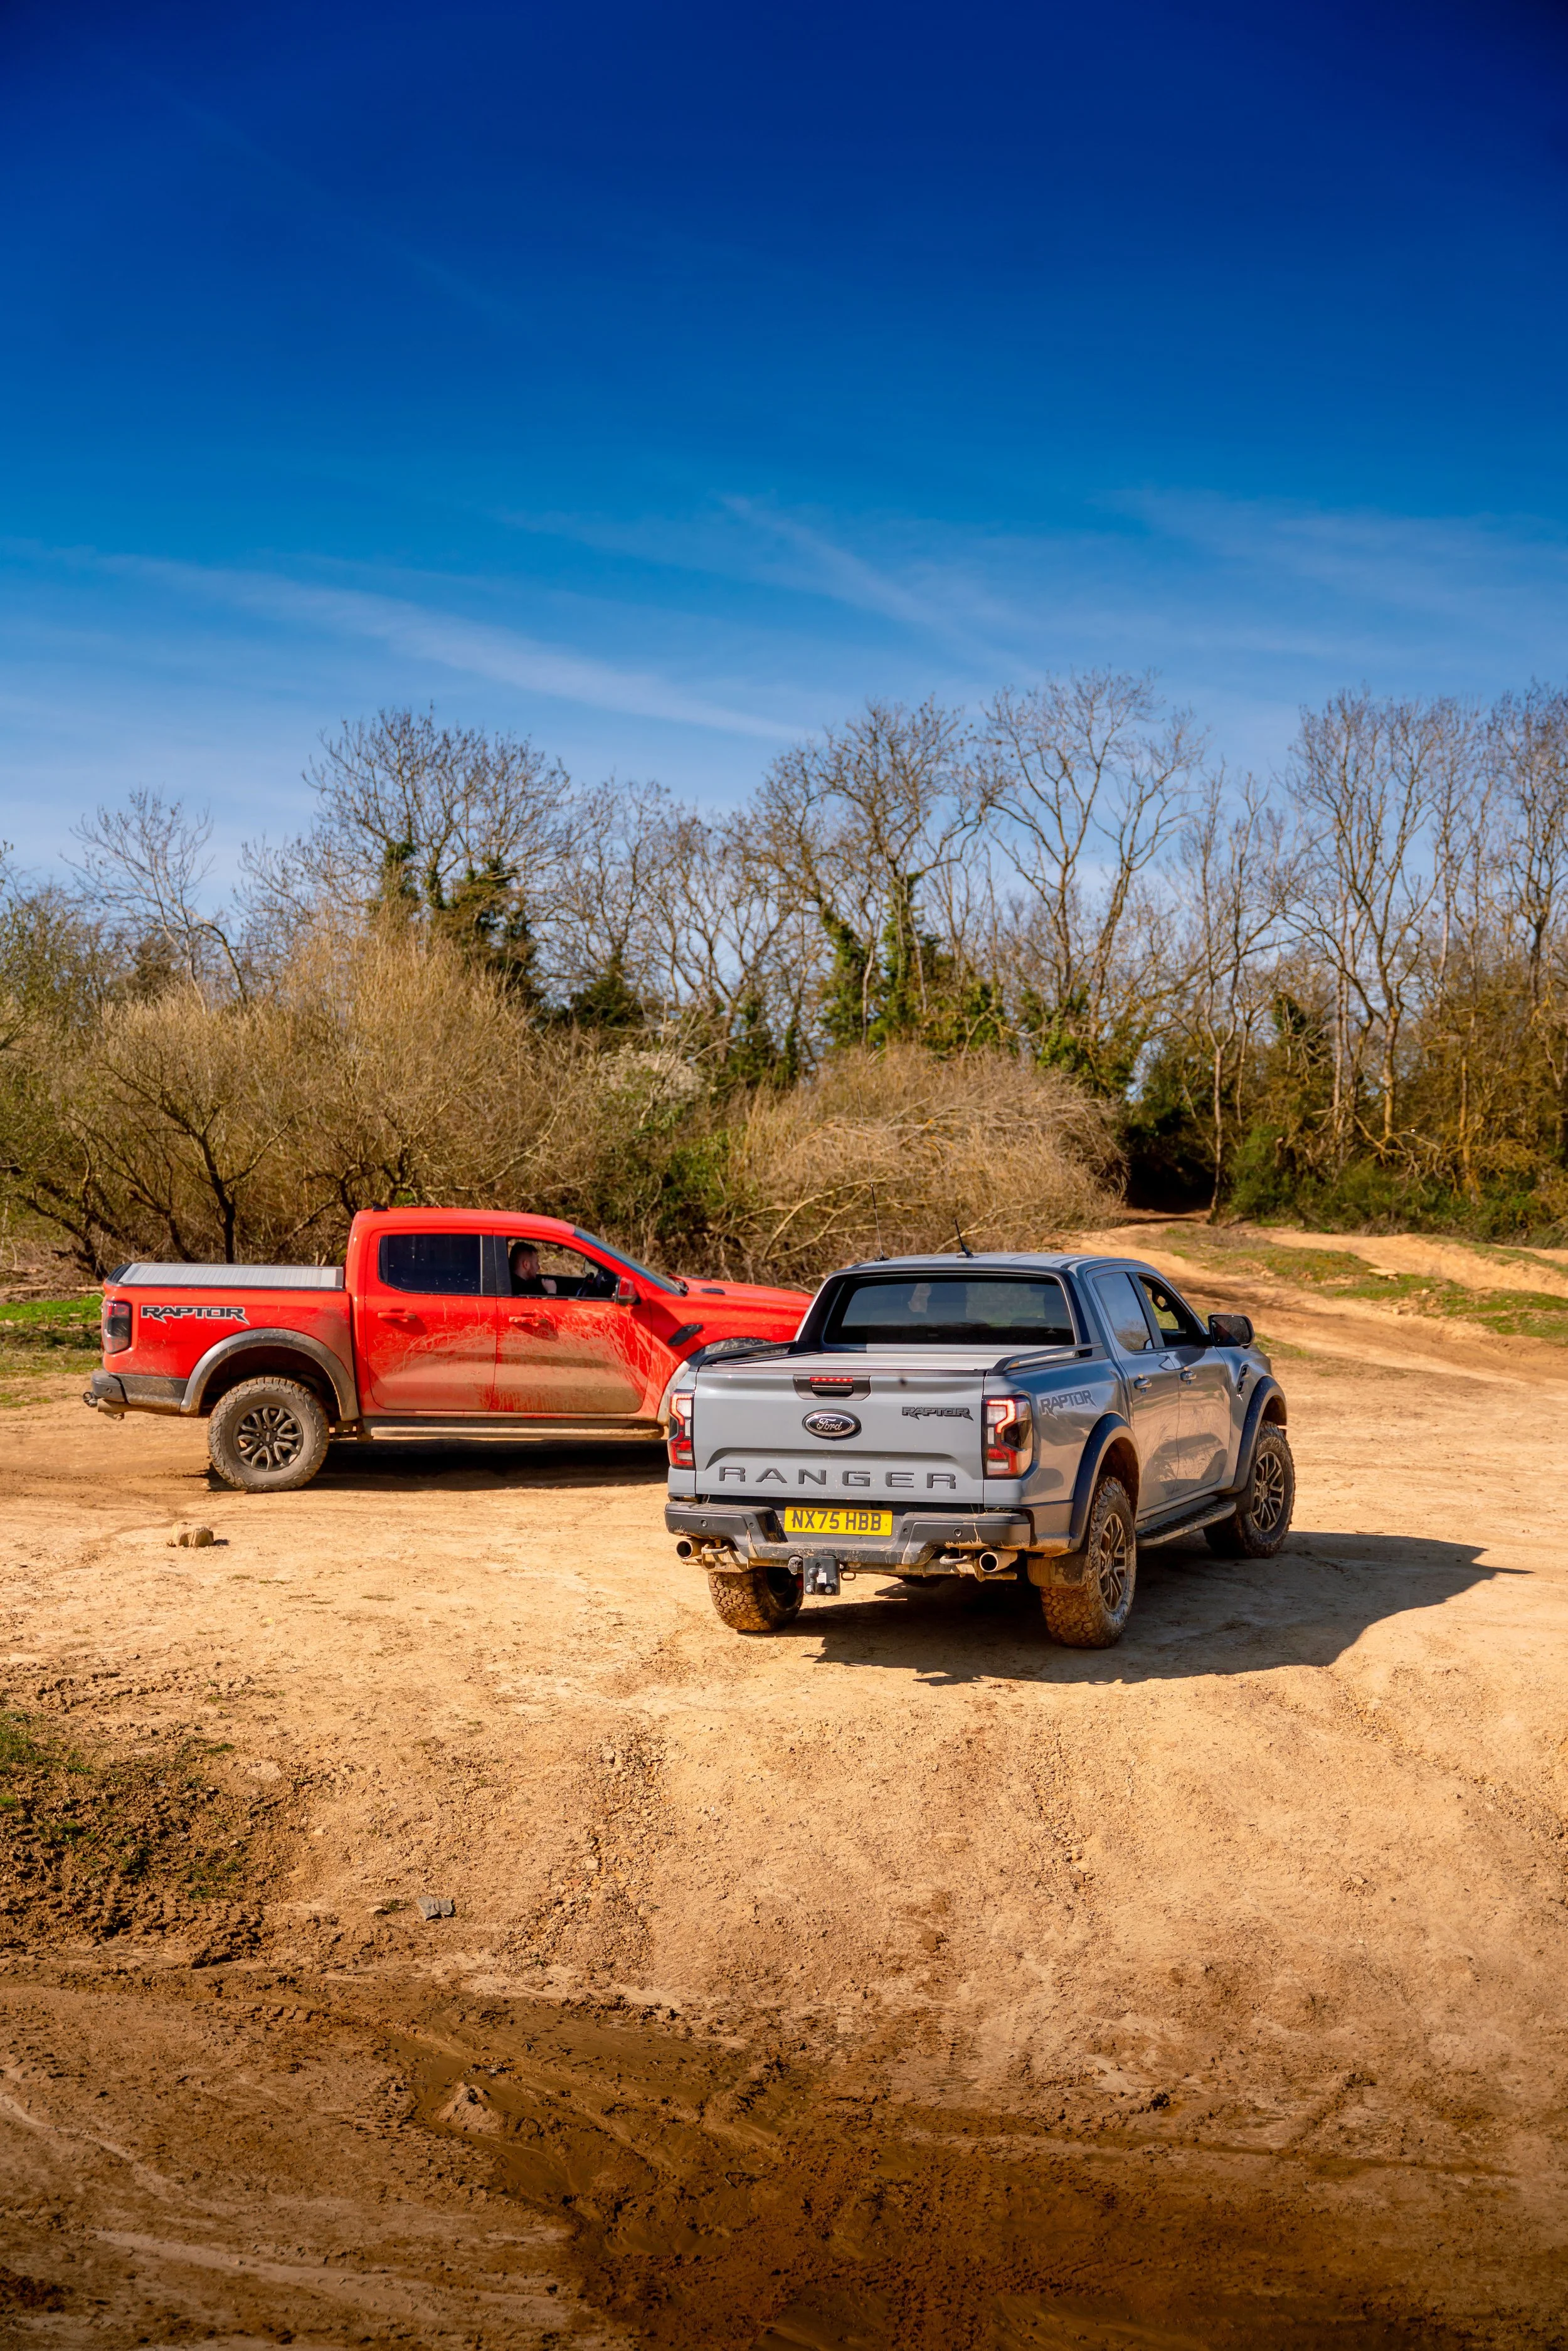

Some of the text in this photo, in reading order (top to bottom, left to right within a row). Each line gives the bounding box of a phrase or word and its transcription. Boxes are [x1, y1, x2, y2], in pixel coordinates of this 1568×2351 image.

[141, 1305, 250, 1325] RAPTOR
[901, 1406, 974, 1421] RAPTOR
[1040, 1389, 1099, 1420] RAPTOR
[816, 1418, 842, 1430] Ford
[719, 1467, 956, 1489] RANGER
[792, 1510, 882, 1531] NX75 HBB
